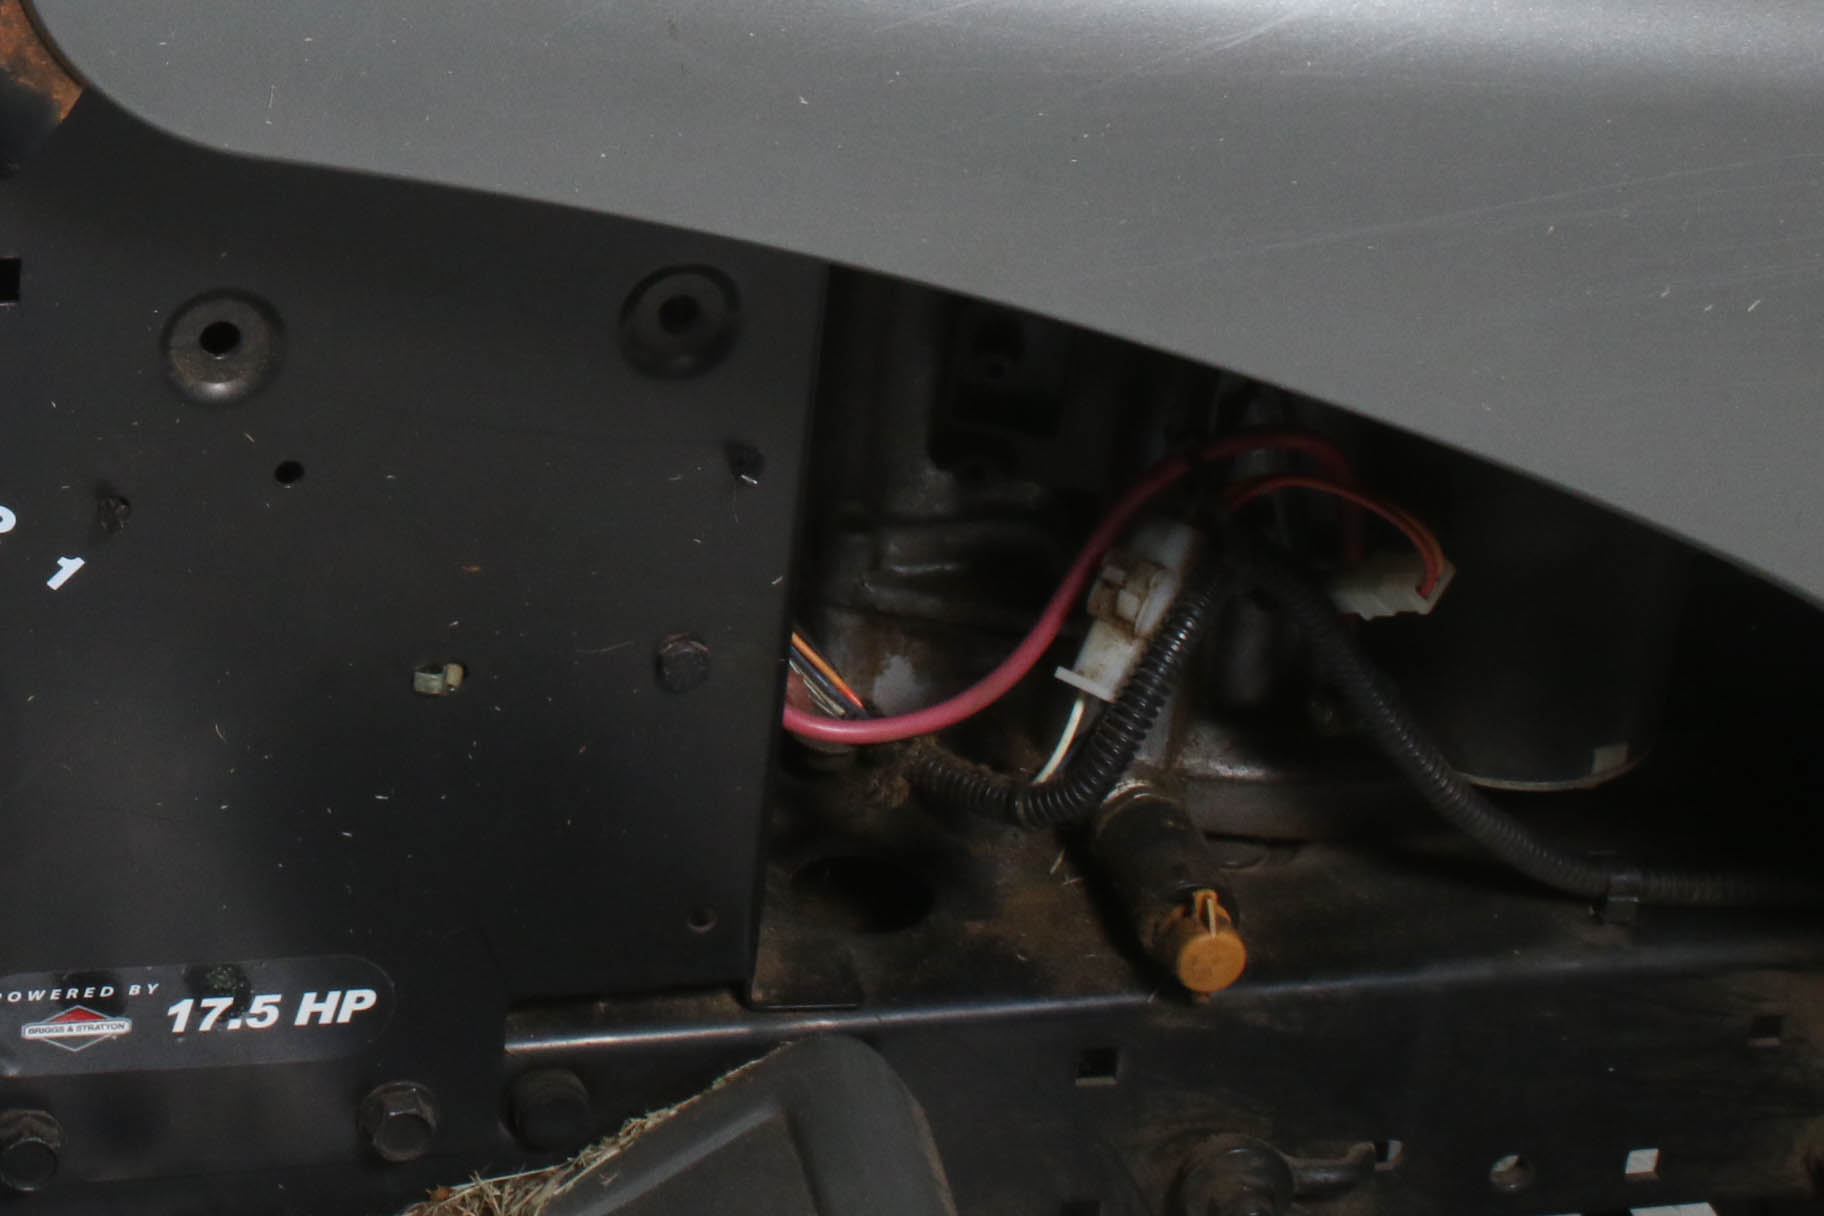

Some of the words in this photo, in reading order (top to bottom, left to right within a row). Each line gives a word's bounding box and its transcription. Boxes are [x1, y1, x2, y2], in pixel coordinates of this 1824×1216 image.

[46, 555, 86, 591] 1
[129, 983, 159, 996] BY
[167, 994, 281, 1033] 17.5
[294, 989, 376, 1026] HP
[28, 1025, 65, 1035] BRIGGS
[67, 1024, 74, 1033] &
[76, 1022, 125, 1033] STRATTON
